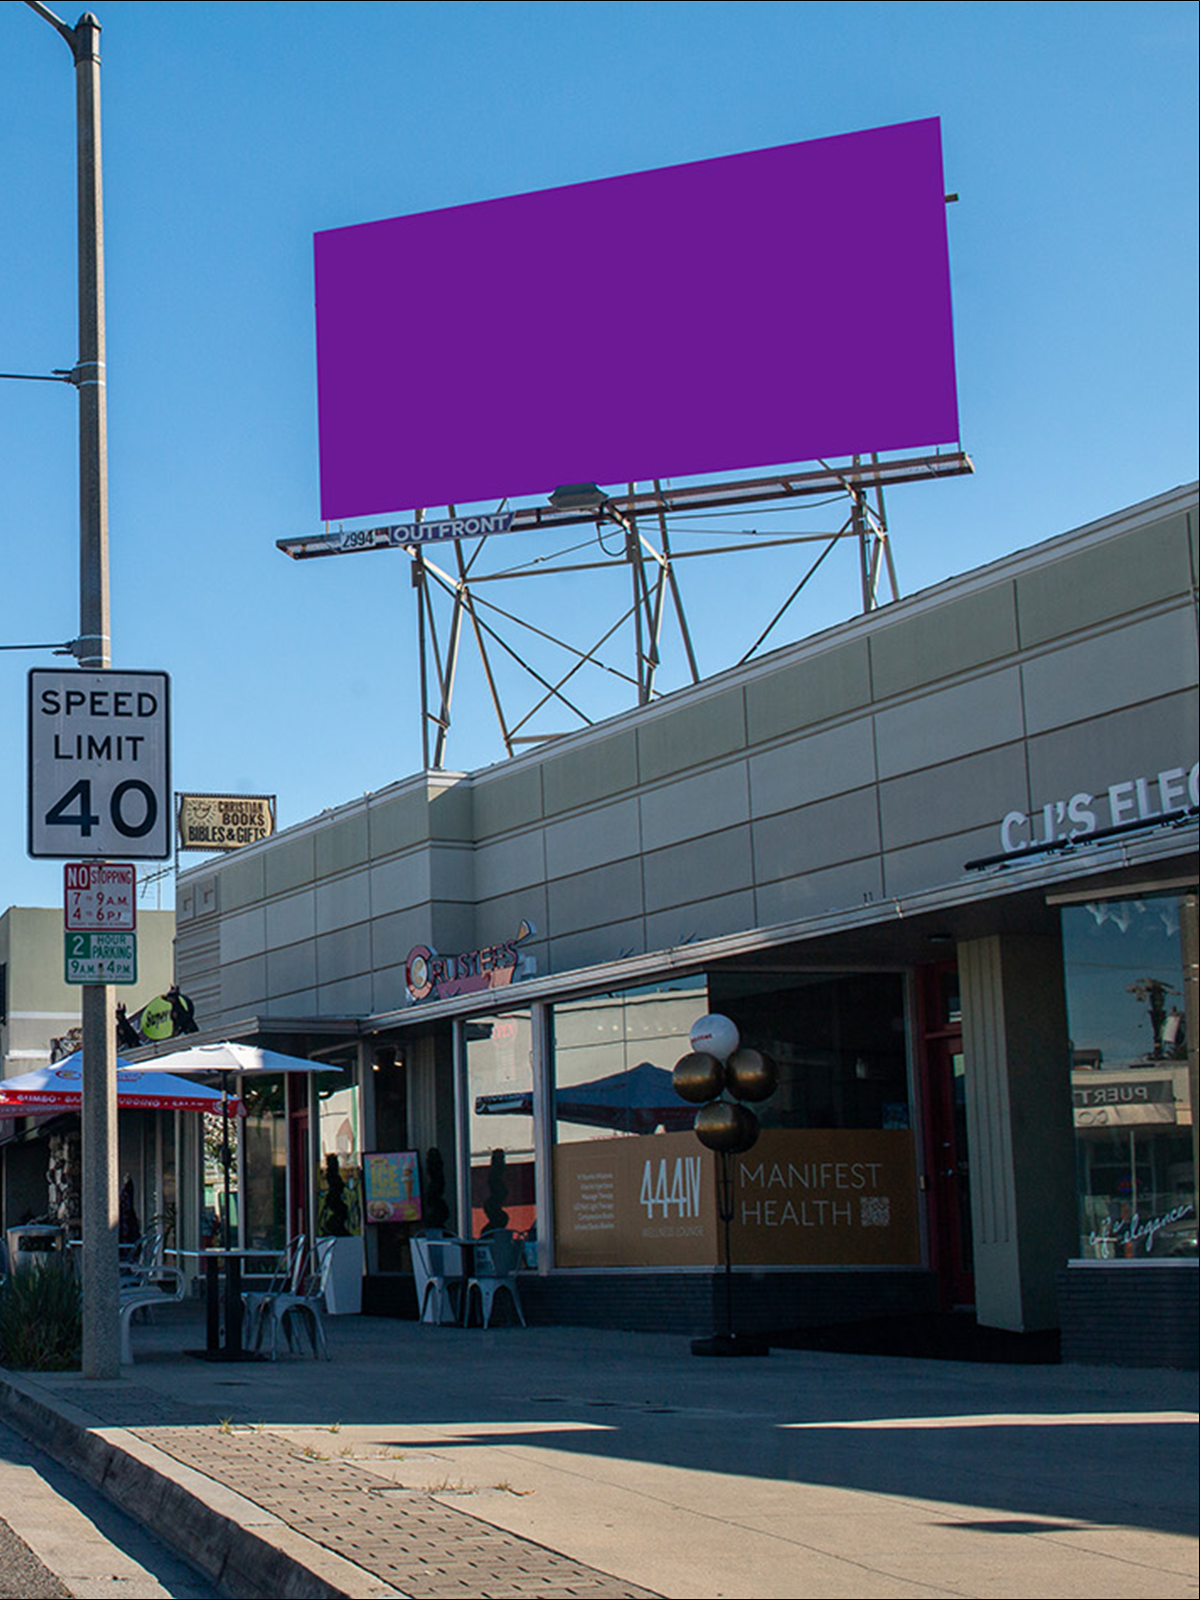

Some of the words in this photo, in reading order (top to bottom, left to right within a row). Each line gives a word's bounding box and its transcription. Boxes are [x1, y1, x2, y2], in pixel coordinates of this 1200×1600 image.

[393, 514, 510, 542] OUTFRONT
[342, 530, 374, 548] 2994
[41, 690, 158, 717] SPEED
[54, 735, 145, 761] LIMIT
[45, 779, 158, 838] 40
[218, 801, 263, 813] CHRISTIAN
[222, 813, 265, 825] BOOKS
[189, 826, 225, 842] BIBLES
[226, 828, 235, 841] &
[237, 827, 267, 843] GIFTS
[68, 867, 88, 887] NO
[91, 869, 132, 884] STOPPING
[73, 892, 81, 905] 7
[72, 907, 81, 920] 4
[72, 935, 84, 955] 2
[97, 935, 126, 944] HOUR
[93, 946, 132, 959] PARKING
[65, 1095, 82, 1104] BA
[118, 1097, 161, 1107] UDDING
[371, 1165, 399, 1188] ICE
[740, 1163, 882, 1189] MANIFEST
[640, 1157, 701, 1219] 444IV
[742, 1200, 851, 1226] HEALTH
[1120, 1204, 1194, 1252] elegance
